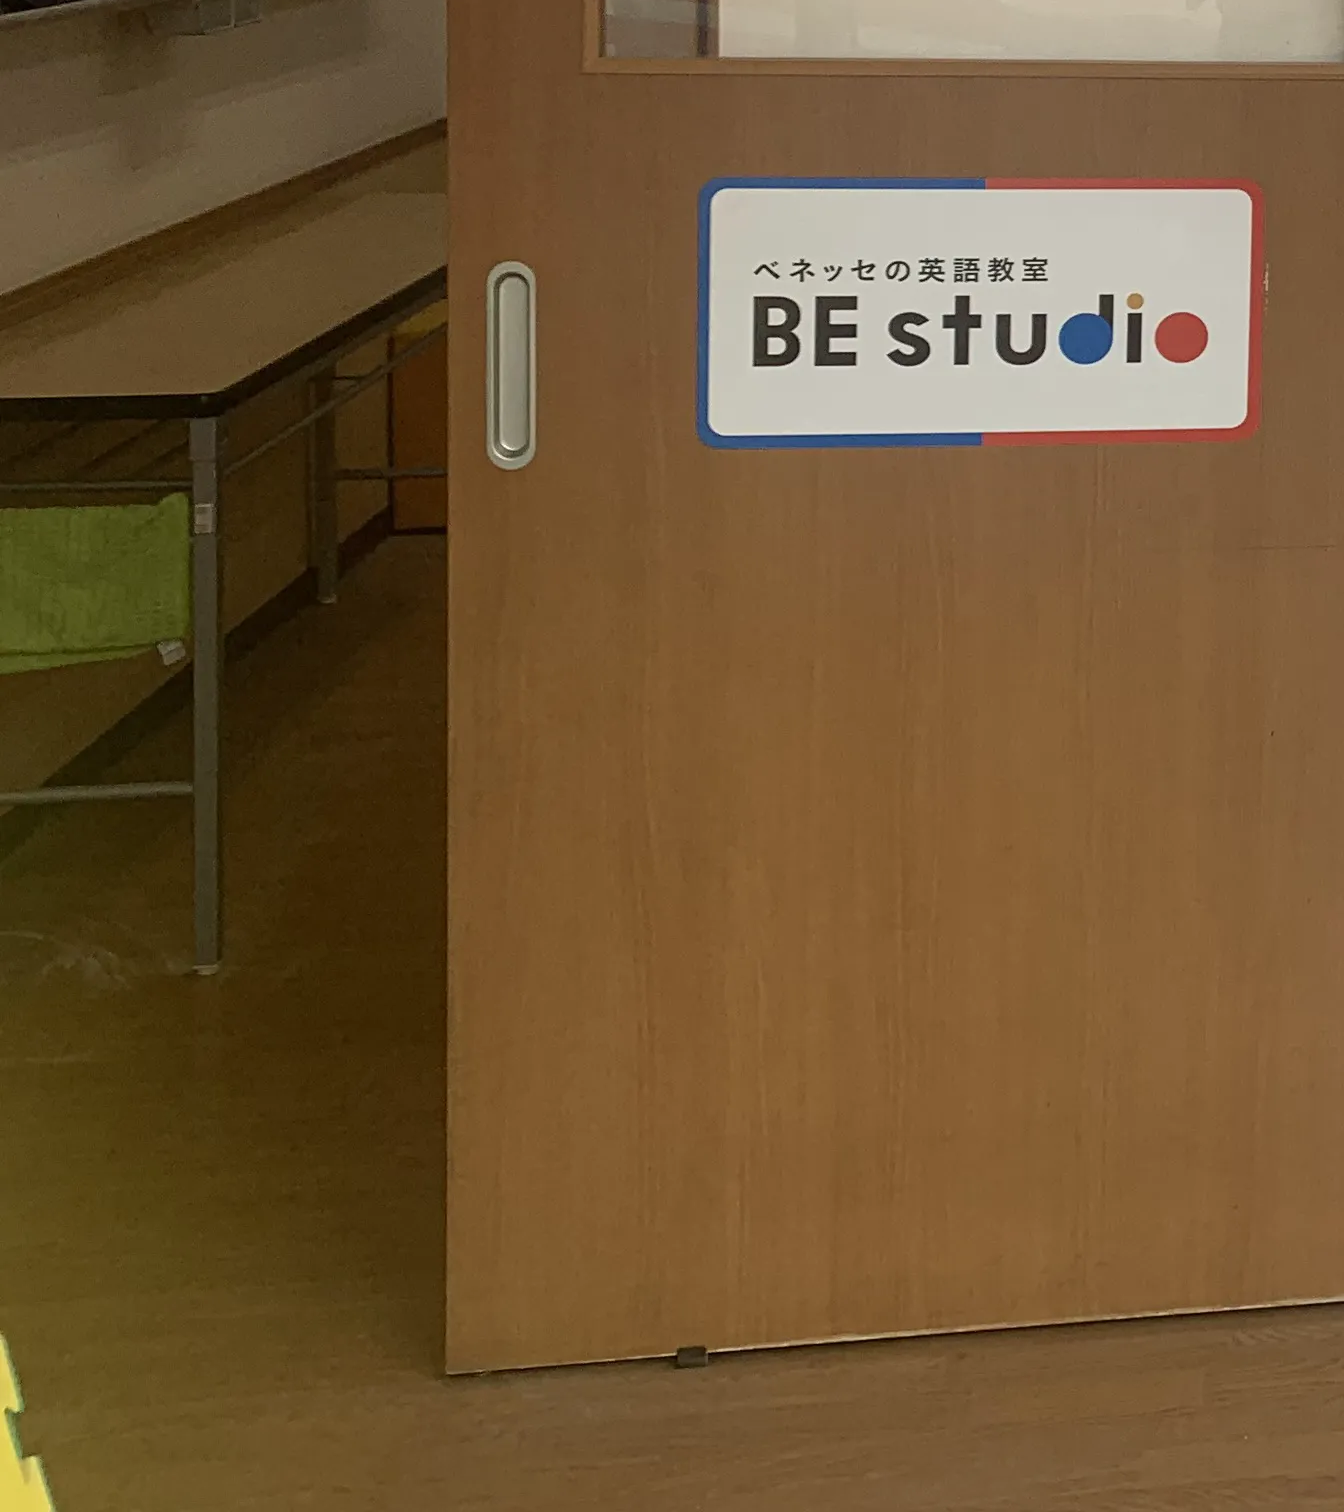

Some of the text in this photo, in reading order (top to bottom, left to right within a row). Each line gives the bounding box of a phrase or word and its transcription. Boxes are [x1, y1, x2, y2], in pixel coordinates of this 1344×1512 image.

[753, 256, 1049, 284] ベネッセの英語教室
[752, 292, 1209, 367] BE studio
